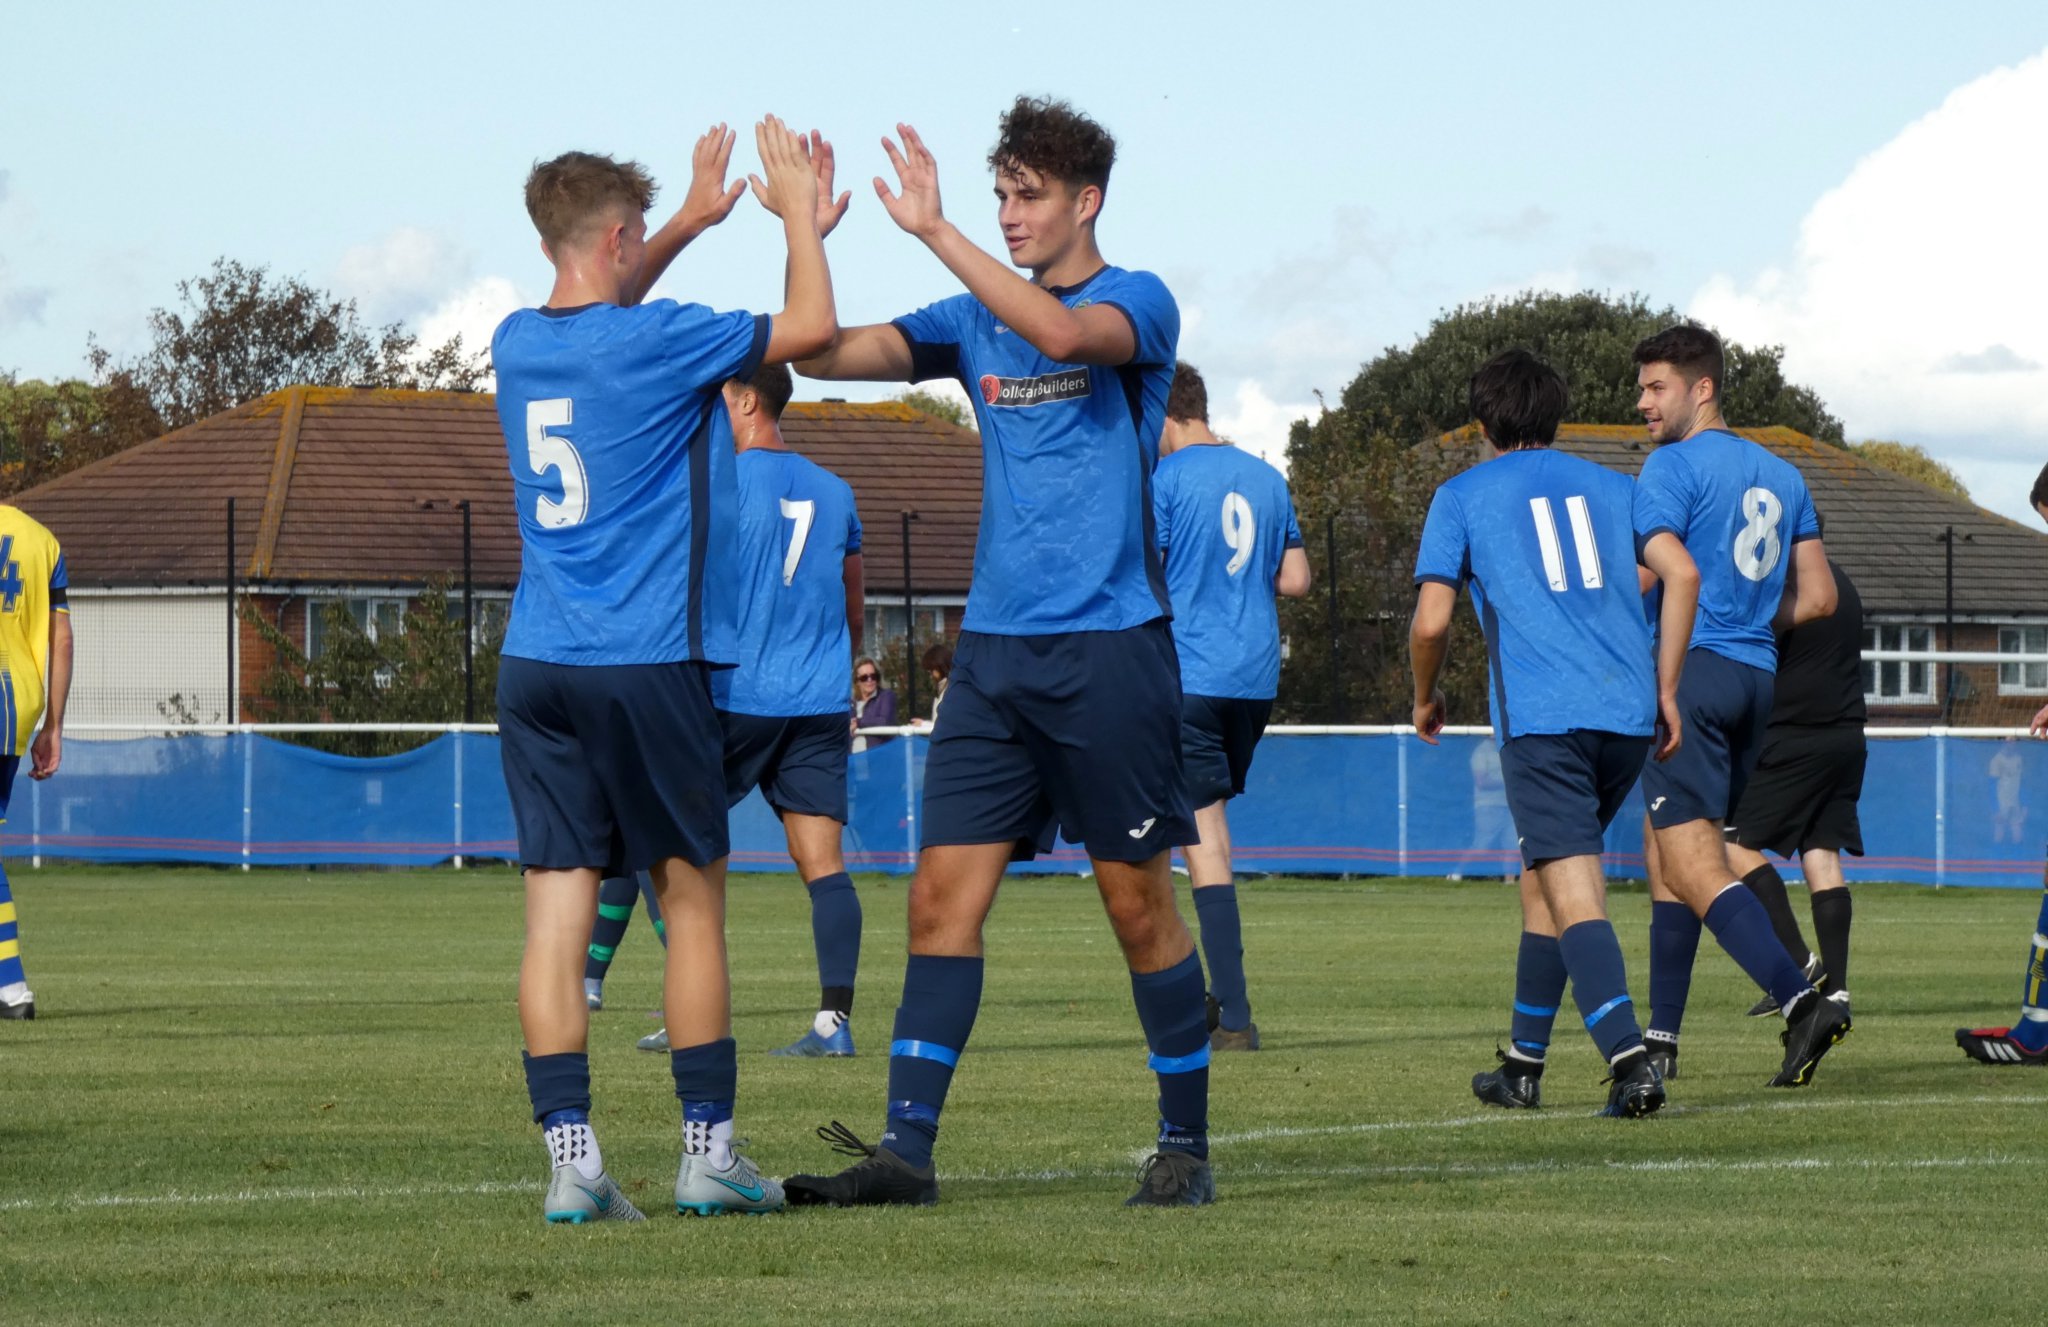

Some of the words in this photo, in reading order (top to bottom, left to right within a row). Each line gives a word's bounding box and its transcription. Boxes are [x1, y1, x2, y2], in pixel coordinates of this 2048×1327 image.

[527, 398, 589, 529] 5
[780, 498, 814, 587] 7
[1222, 492, 1255, 576] 9
[1530, 496, 1603, 591] 11
[1734, 487, 1782, 581] 8
